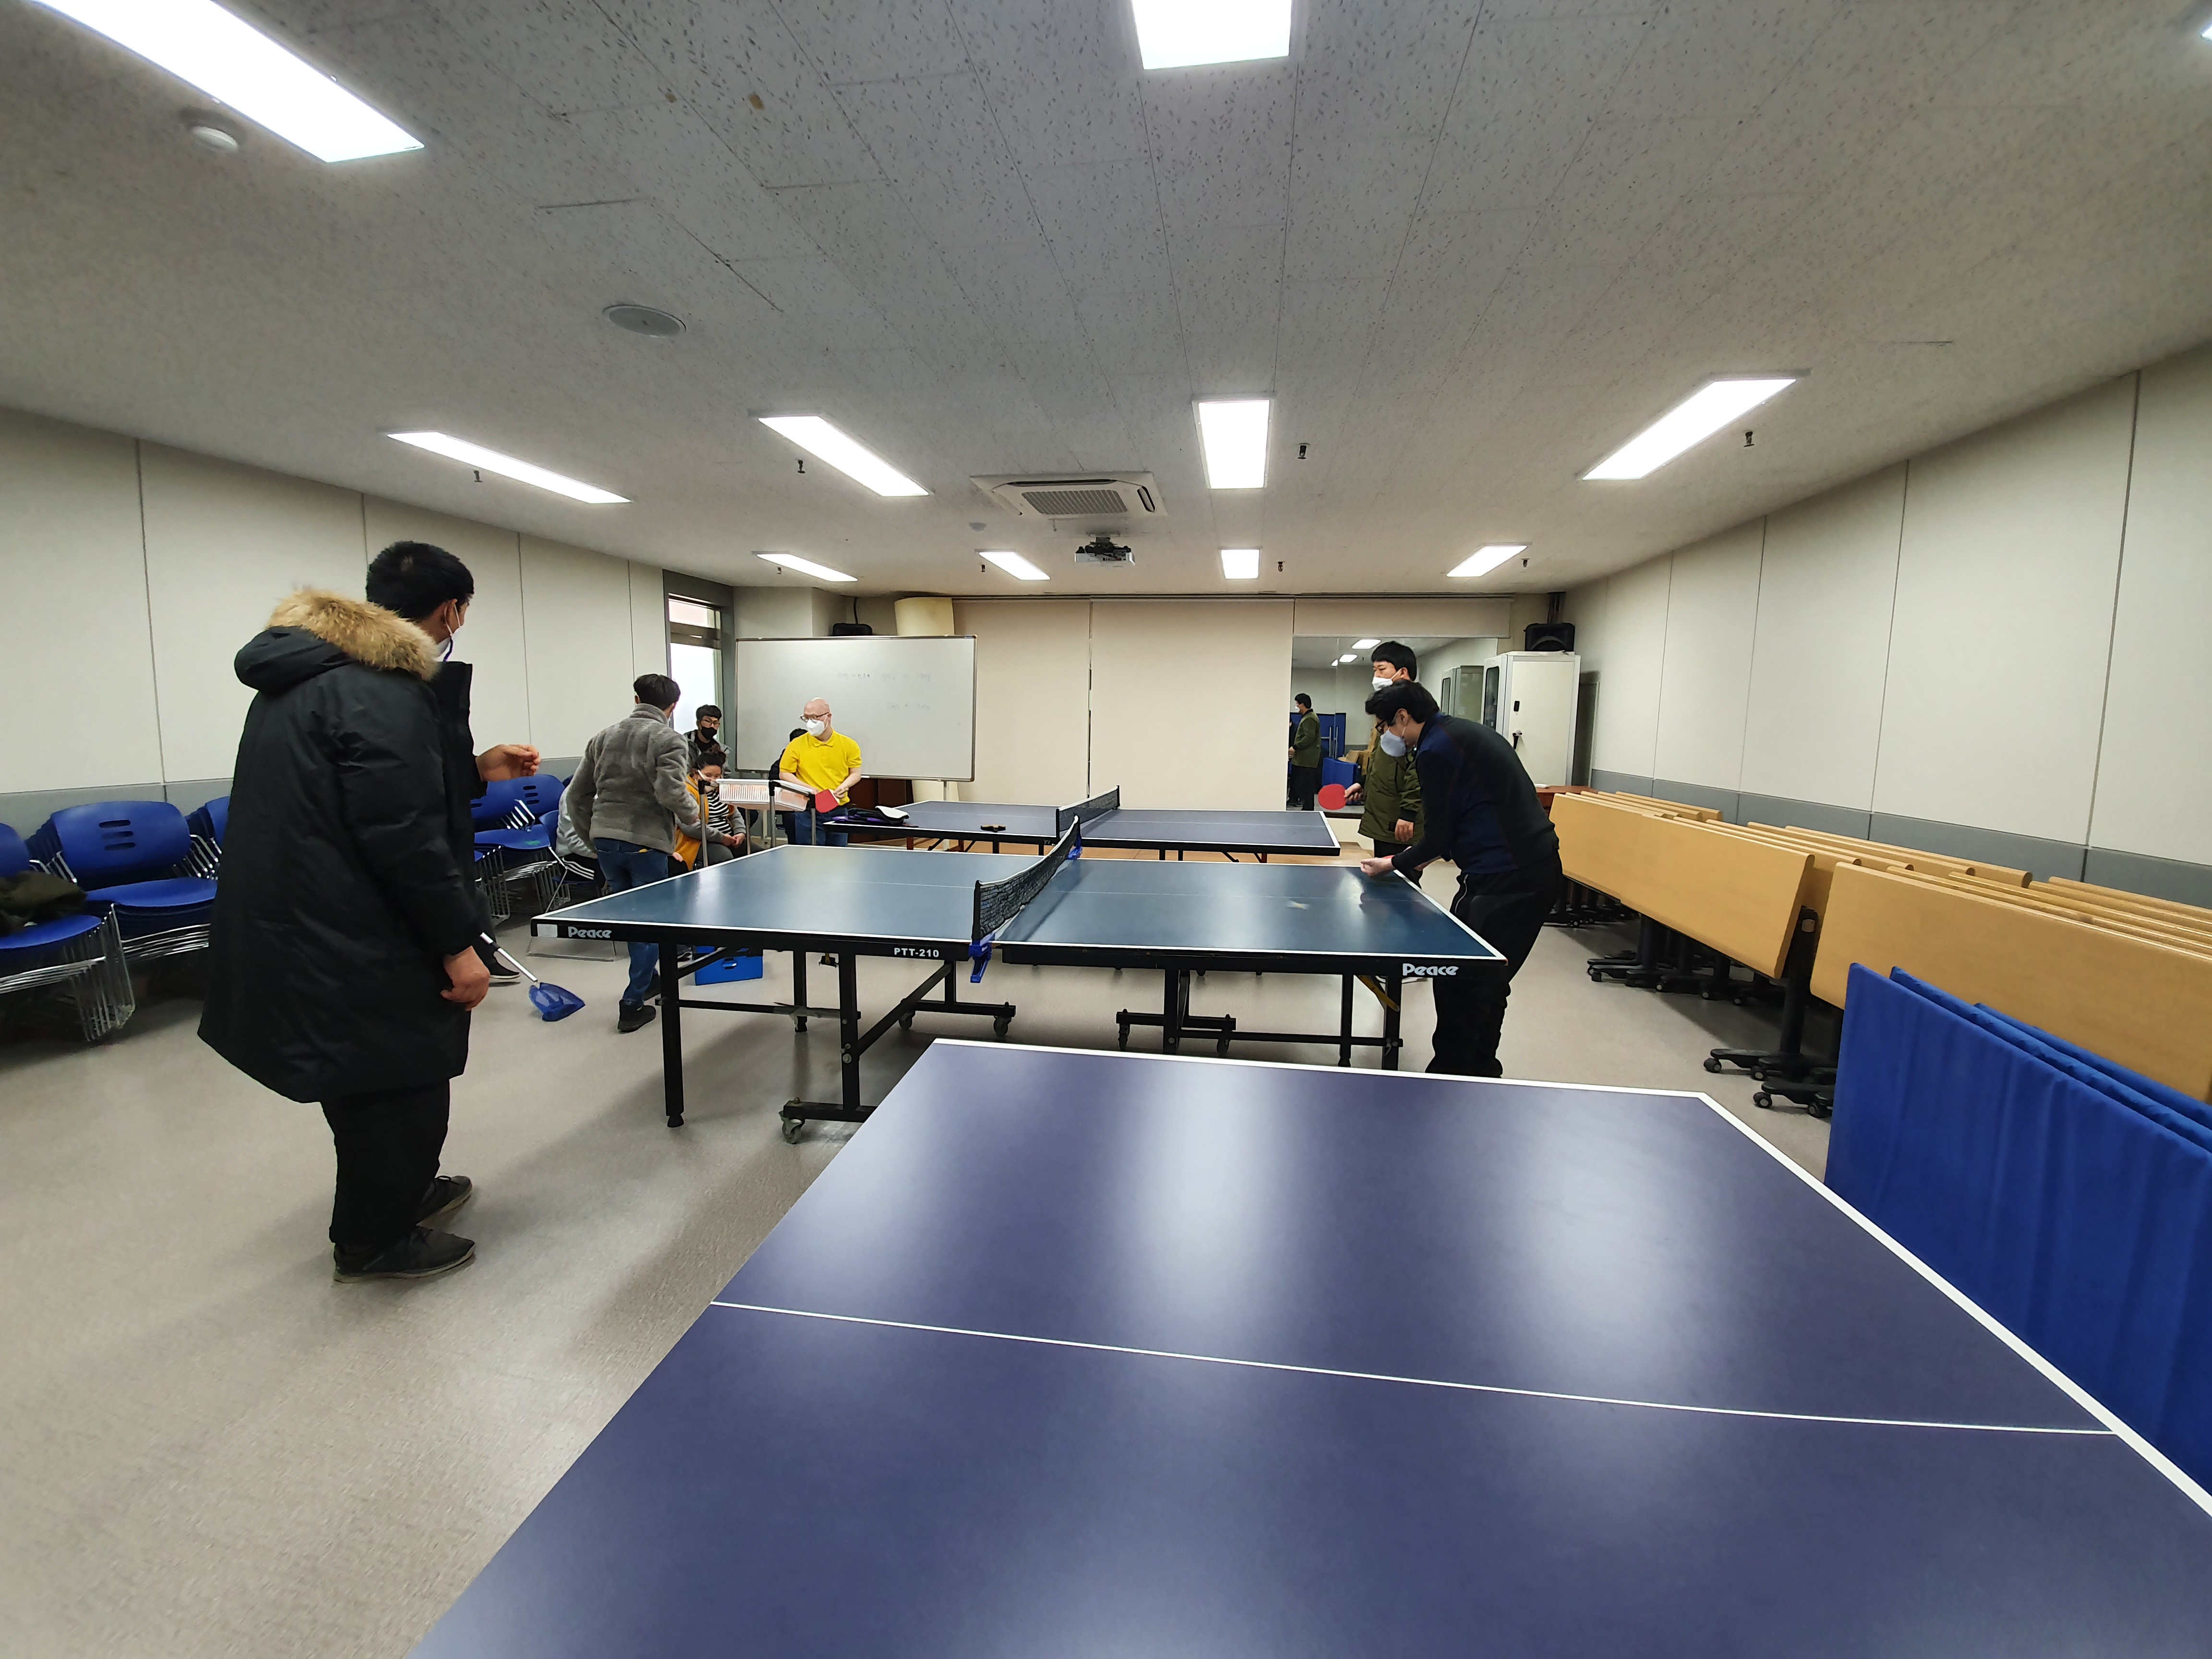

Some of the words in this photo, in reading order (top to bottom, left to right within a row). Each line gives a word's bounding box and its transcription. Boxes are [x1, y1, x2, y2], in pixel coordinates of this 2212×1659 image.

[567, 926, 613, 938] Peace
[894, 947, 939, 958] PTT-210
[1402, 963, 1459, 976] Peace
